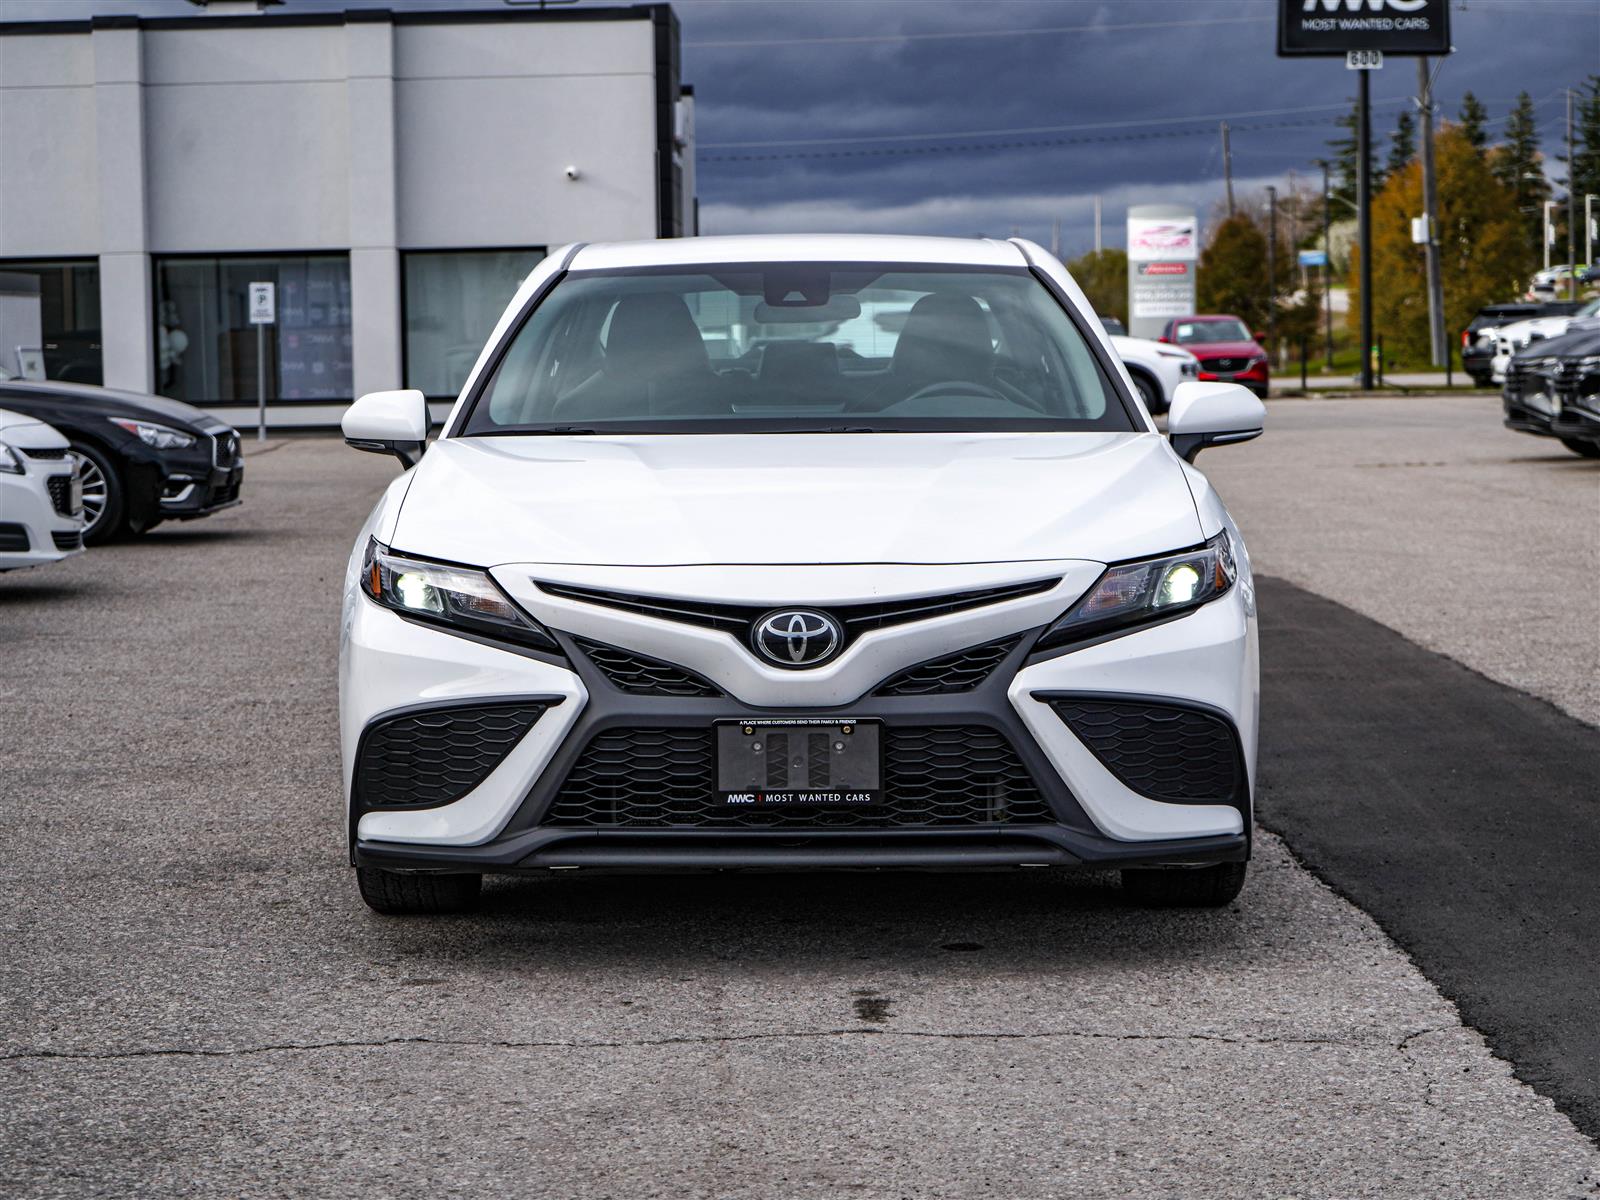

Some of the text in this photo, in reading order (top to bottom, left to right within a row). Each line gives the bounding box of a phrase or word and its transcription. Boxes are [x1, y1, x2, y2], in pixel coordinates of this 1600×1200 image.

[1302, 17, 1430, 30] MOST WANTED CARS
[766, 794, 794, 802] MOST
[799, 794, 841, 802] WANTED
[846, 794, 871, 802] CARS
